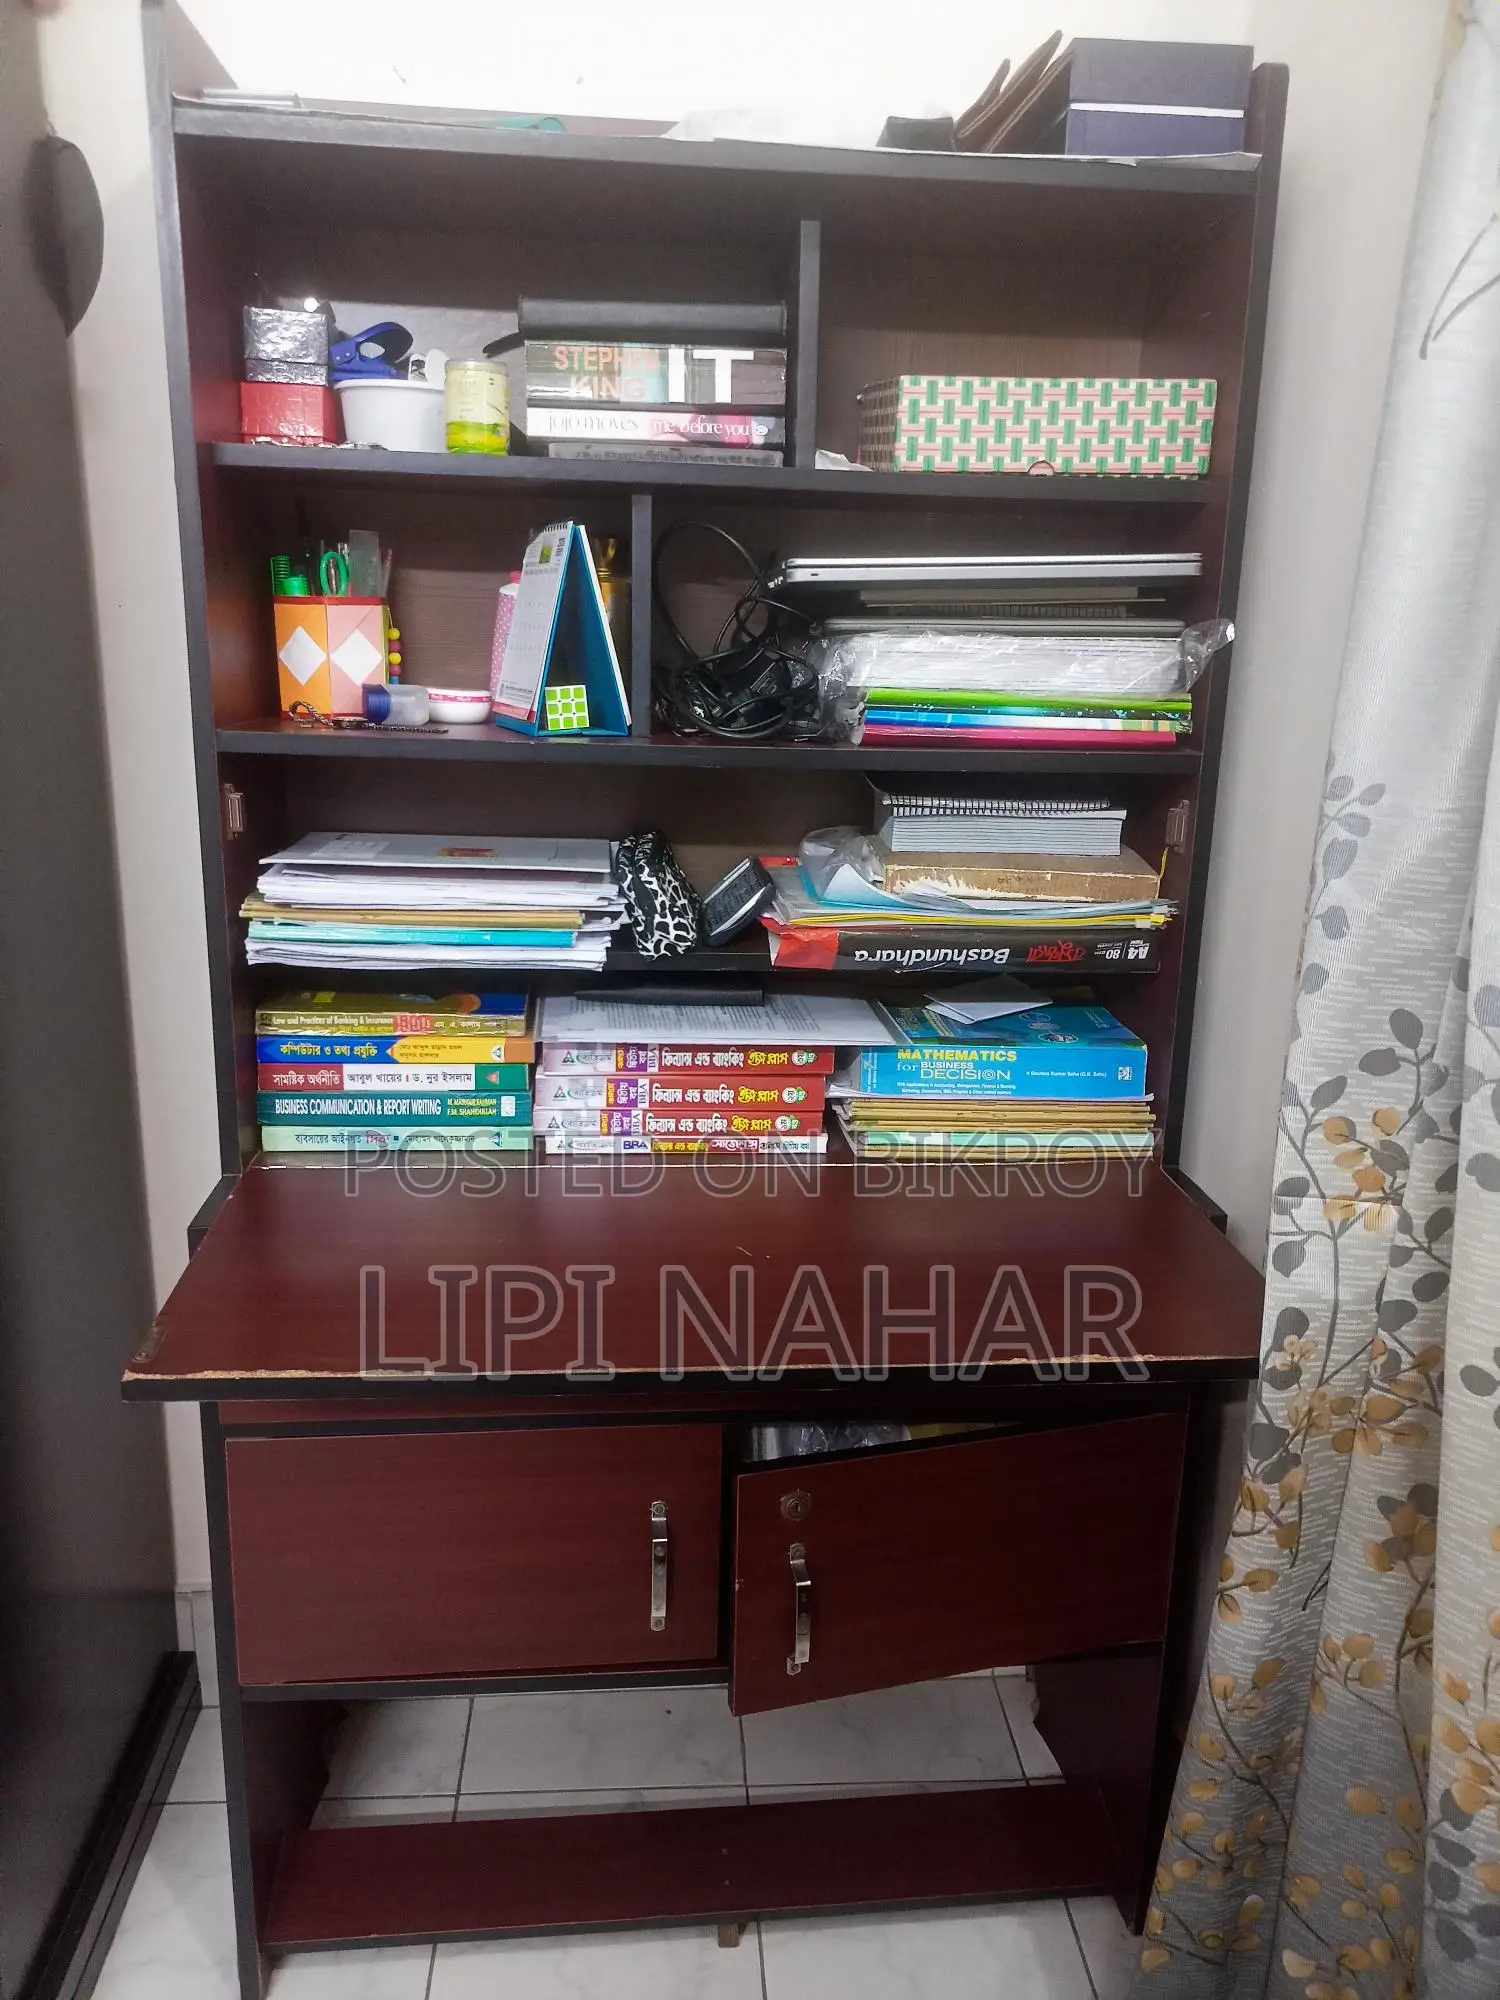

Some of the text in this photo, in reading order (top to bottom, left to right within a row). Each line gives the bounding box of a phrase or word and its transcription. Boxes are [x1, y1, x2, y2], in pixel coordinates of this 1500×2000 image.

[554, 346, 660, 372] STEPHEN
[668, 348, 754, 403] IT
[569, 375, 647, 399] KING
[654, 415, 749, 439] me before you
[854, 948, 1010, 966] Bashundhara
[1105, 949, 1121, 960] 80
[1127, 947, 1149, 960] A4
[324, 1045, 331, 1055] ও
[648, 1047, 656, 1068] BBA
[661, 1047, 692, 1067] ফিন্যান্স
[712, 1047, 744, 1068] ব্যাংকিং
[897, 1048, 1018, 1062] MATHEMATICS
[896, 1061, 974, 1072] for BUSINESS
[920, 1068, 1011, 1081] DECISION
[273, 1069, 341, 1086] সামষ্টিক অর্থনীতি
[347, 1073, 372, 1084] আবুল
[375, 1073, 402, 1083] খায়ের
[441, 1070, 472, 1083] ইসলাম
[639, 1083, 647, 1104] BBA
[652, 1083, 683, 1103] ফিন্যান্স
[703, 1083, 735, 1104] ব্যাংকিং
[275, 1098, 442, 1115] BUSINESS COMMUNICATION & REPORT WRITING
[458, 1108, 497, 1116] SHAHIDULLAH
[645, 1112, 676, 1132] ফিন্যান্স
[696, 1113, 728, 1133] ব্যাংকিং
[294, 1134, 329, 1144] ব্যবসায়ের
